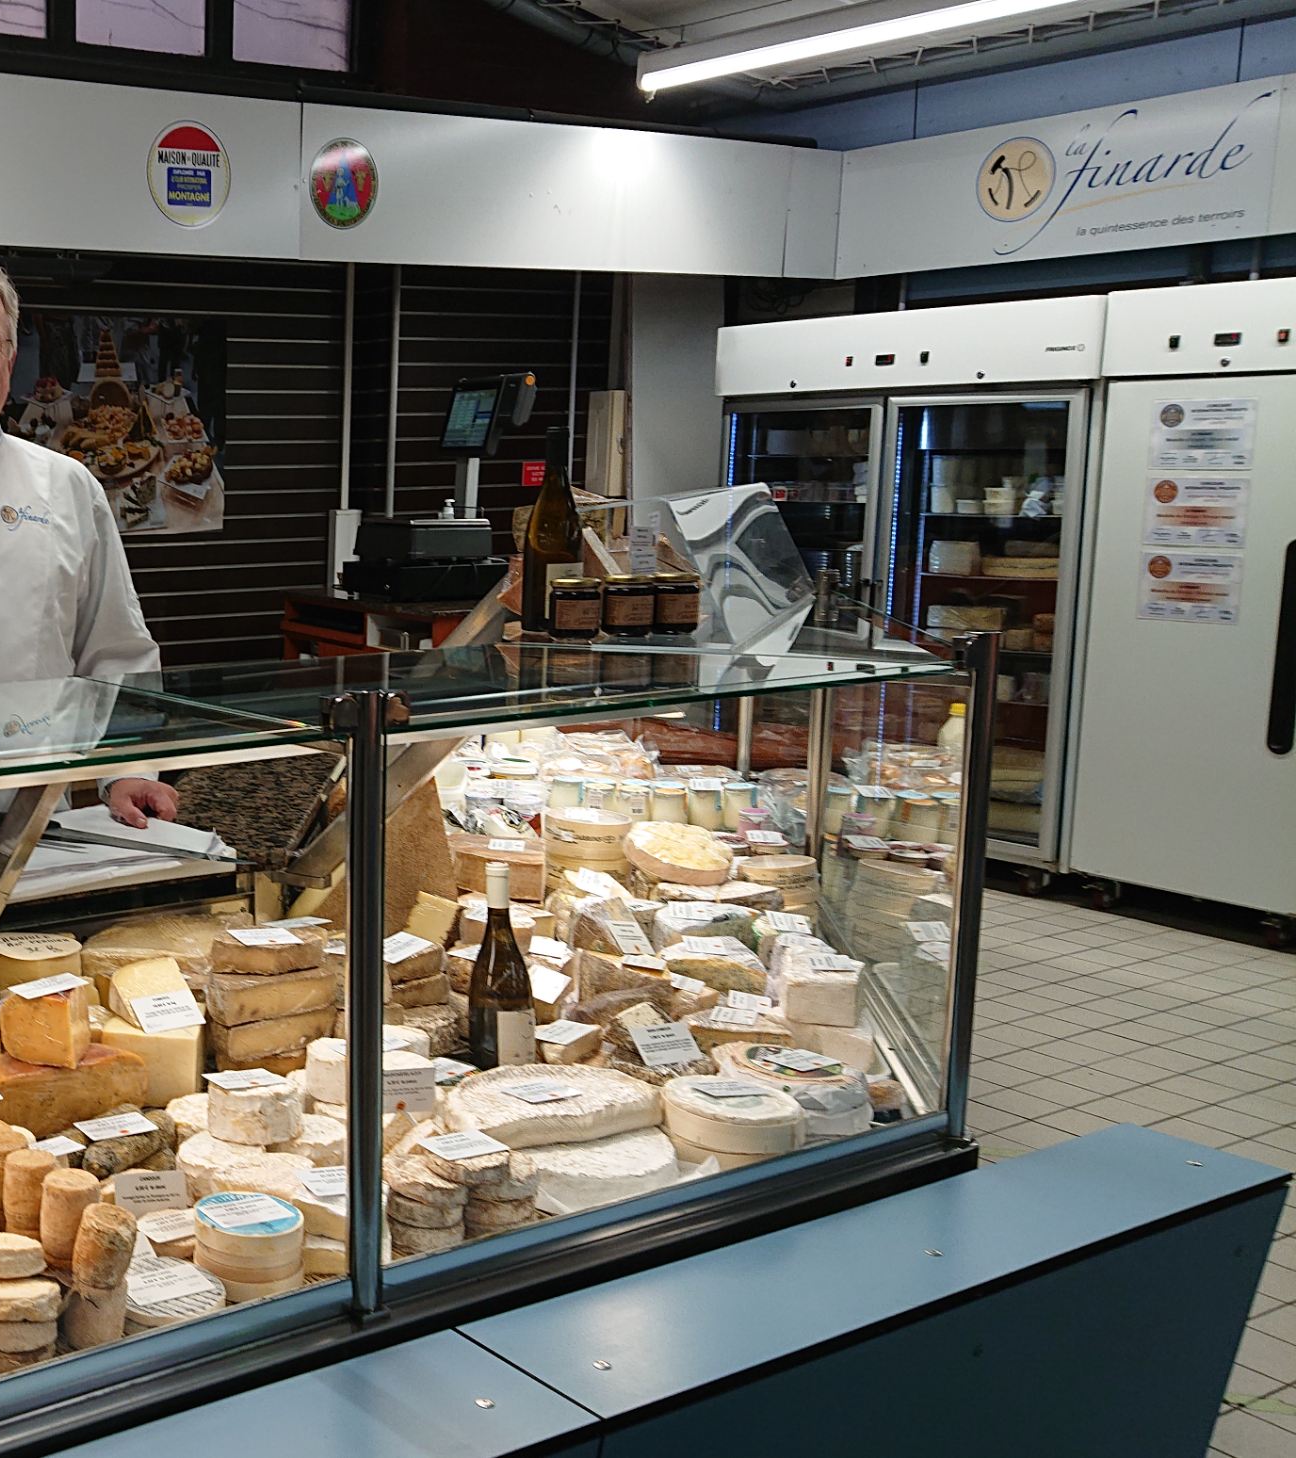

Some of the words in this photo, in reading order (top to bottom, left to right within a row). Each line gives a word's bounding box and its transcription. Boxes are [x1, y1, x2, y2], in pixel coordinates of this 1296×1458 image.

[1064, 123, 1090, 157] la
[157, 150, 187, 165] MAISON
[994, 89, 1277, 256] finarde
[1076, 226, 1086, 236] la
[1089, 217, 1170, 236] quintessence
[1172, 214, 1195, 227] des
[1198, 208, 1246, 223] terroirs
